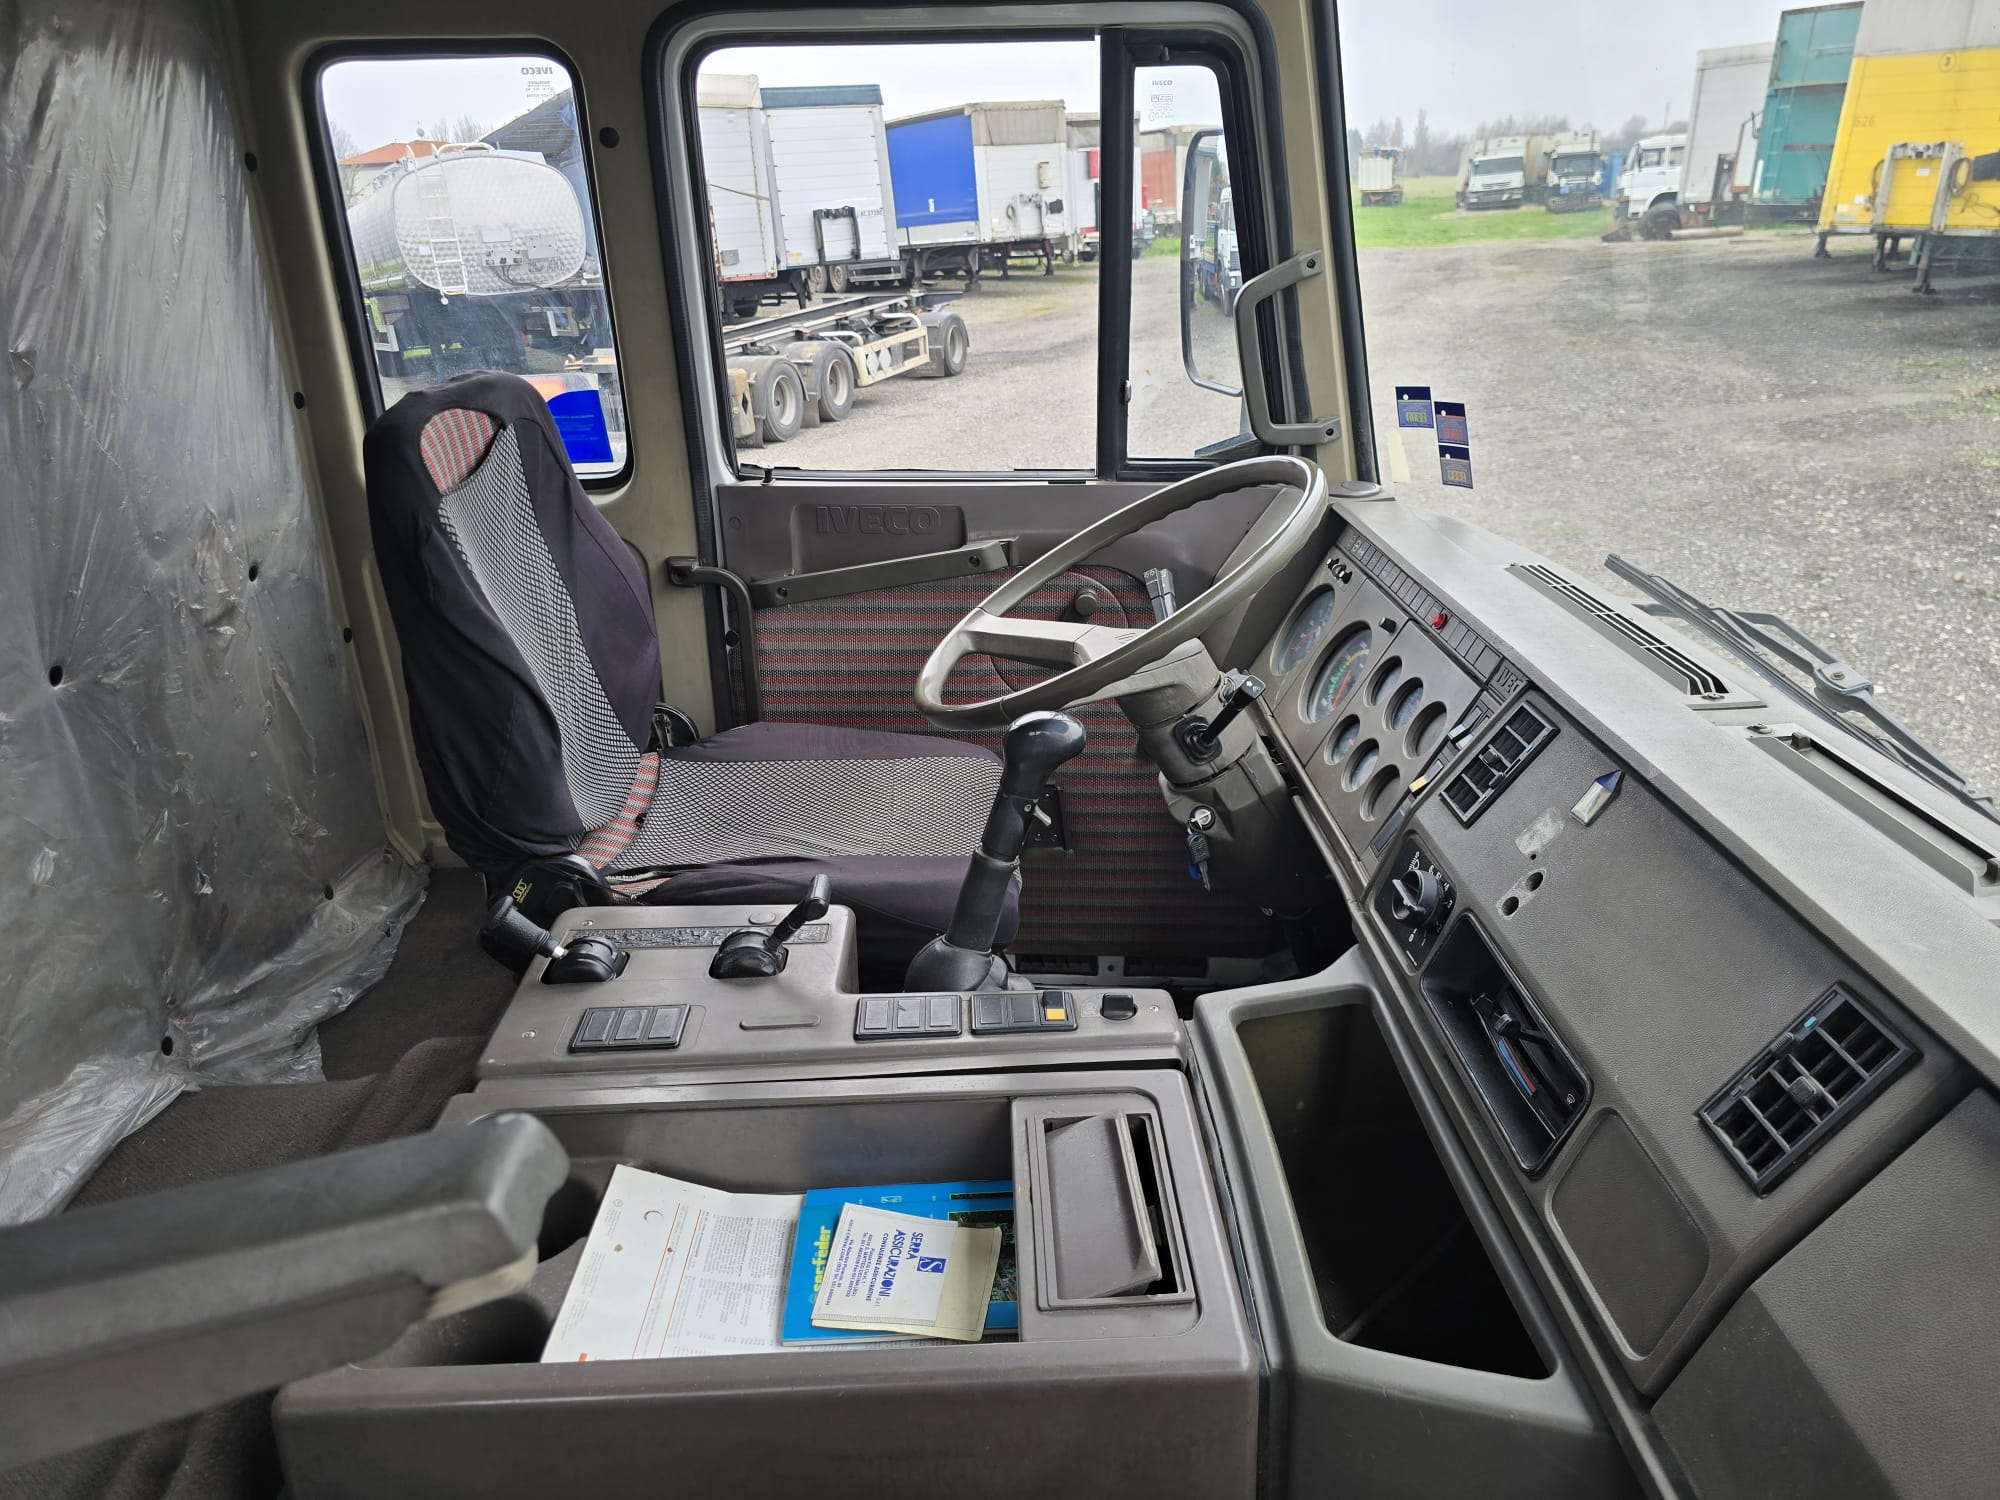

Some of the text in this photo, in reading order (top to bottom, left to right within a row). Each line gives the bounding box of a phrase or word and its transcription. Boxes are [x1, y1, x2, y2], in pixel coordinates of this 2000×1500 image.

[816, 506, 941, 535] IVECO
[865, 1233, 889, 1302] CONSULENZE ASSICURATIVE
[878, 1229, 907, 1297] ASSICURAZIONI
[906, 1232, 924, 1260] SERRA
